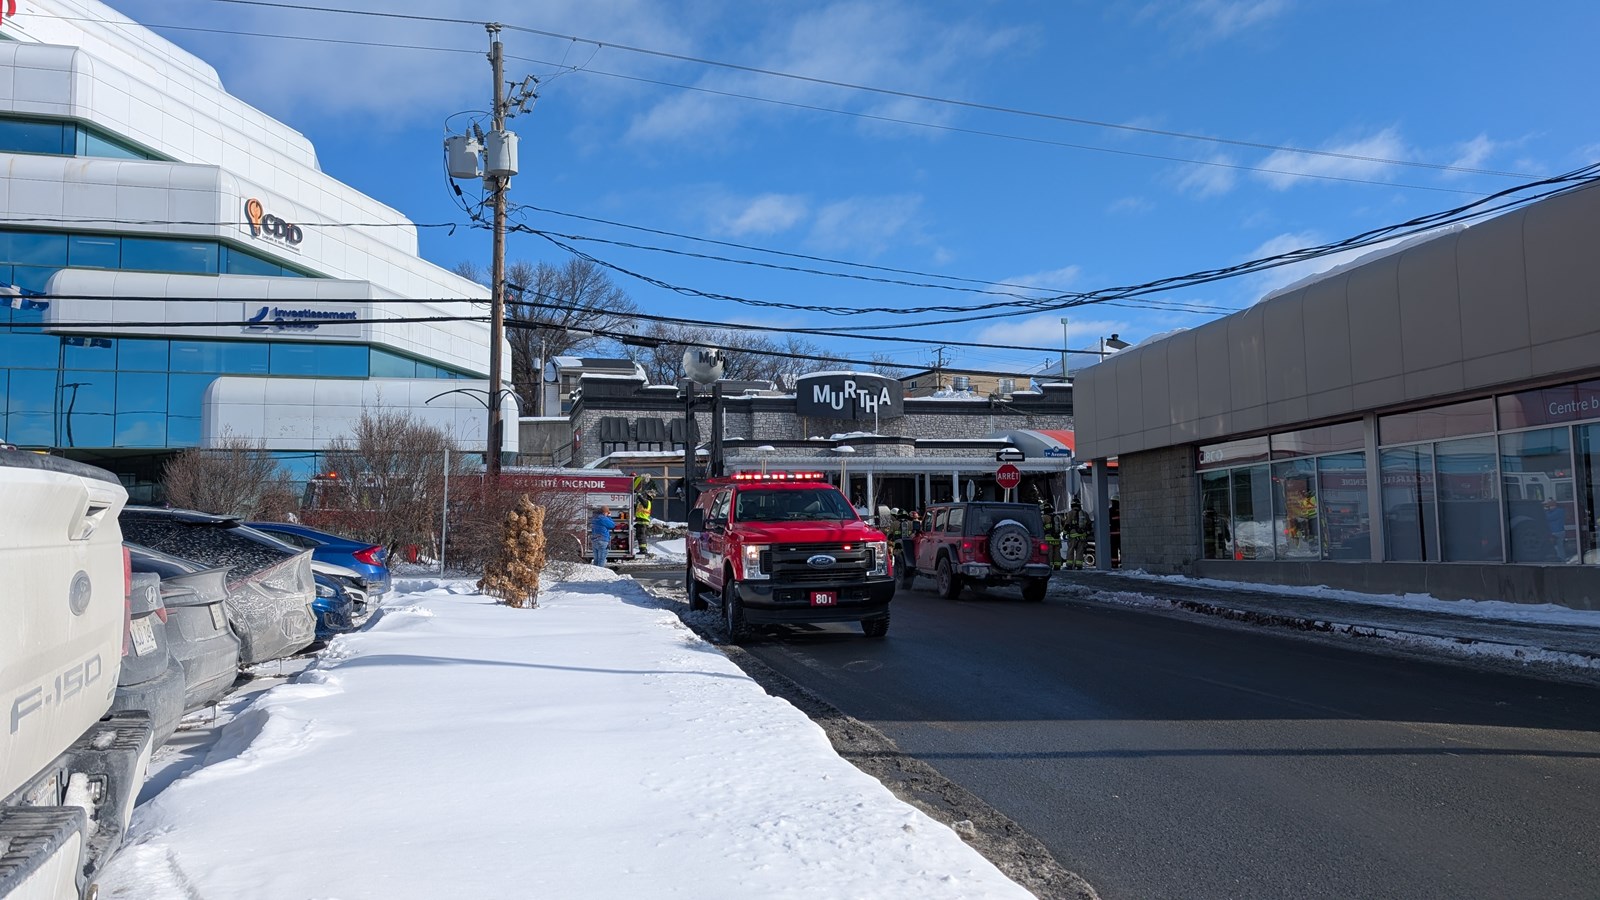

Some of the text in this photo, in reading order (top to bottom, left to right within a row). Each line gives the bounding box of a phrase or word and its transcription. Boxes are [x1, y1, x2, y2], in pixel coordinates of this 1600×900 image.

[274, 307, 357, 320] Investissement
[813, 380, 891, 413] MURTHA
[1549, 400, 1588, 415] Centre
[997, 471, 1019, 480] ARRÊT
[562, 480, 606, 489] INCENDIE
[10, 653, 102, 735] F-150
